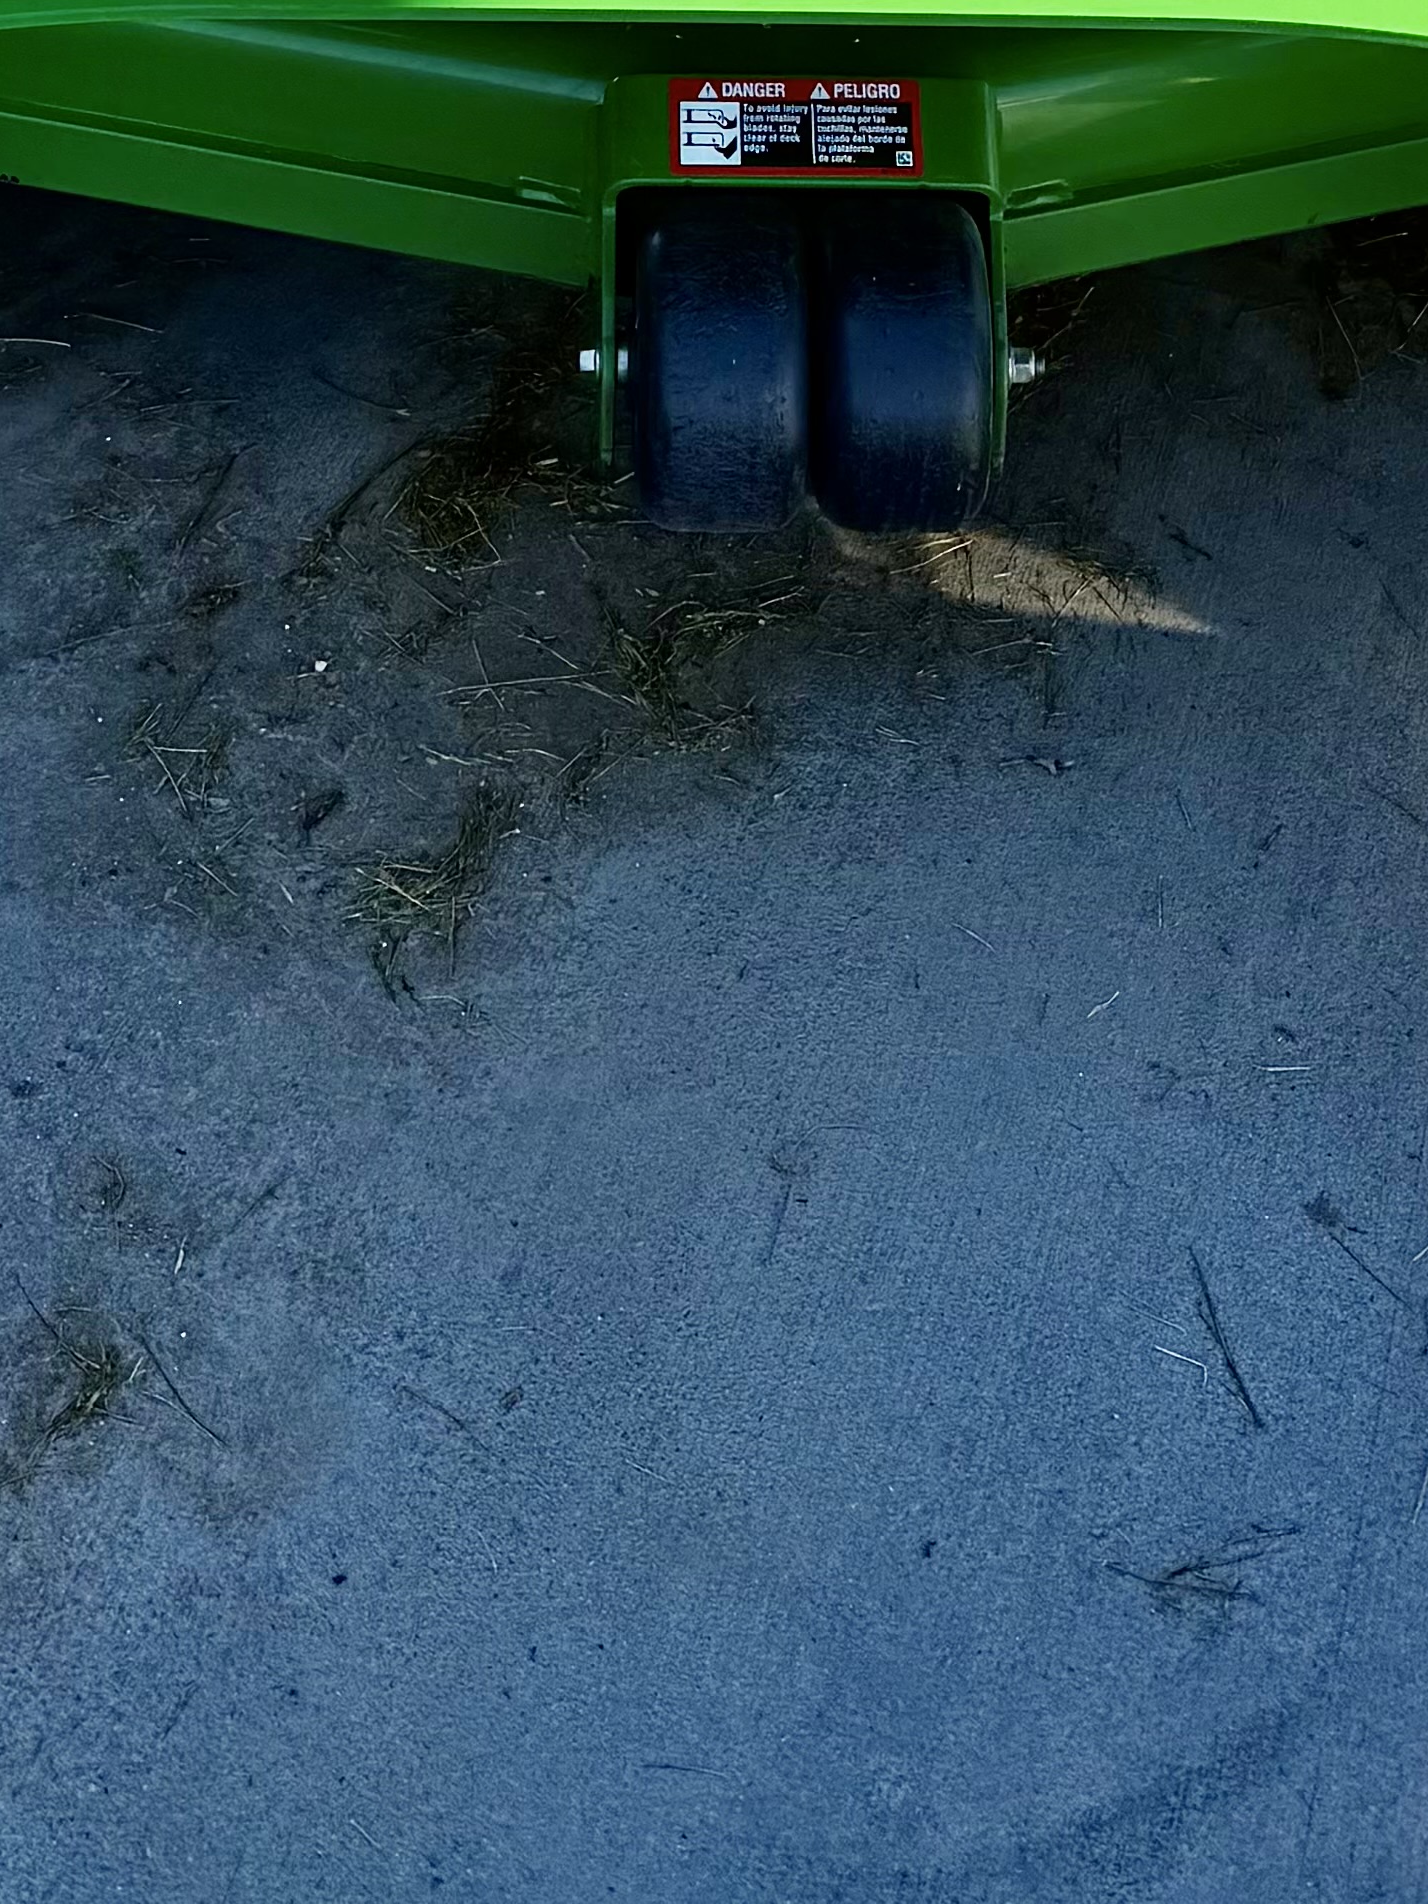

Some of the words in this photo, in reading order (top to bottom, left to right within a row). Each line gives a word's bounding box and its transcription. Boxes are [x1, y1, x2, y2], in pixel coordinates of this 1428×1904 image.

[722, 82, 786, 99] DANGER
[833, 83, 901, 100] PELIGRO
[743, 103, 754, 112] To
[756, 103, 781, 113] avoid
[783, 103, 808, 115] injury
[816, 104, 836, 114] Para
[837, 104, 862, 113] evitar
[862, 104, 898, 114] lesiones
[743, 113, 764, 123] from
[766, 113, 801, 124] rotating
[816, 115, 856, 123] causadas
[857, 115, 872, 125] por
[873, 115, 886, 124] las
[779, 124, 797, 134] stay
[743, 133, 767, 143] clear
[779, 133, 801, 143] deck
[817, 134, 850, 144] alejado
[852, 134, 866, 143] del
[868, 134, 893, 144] borde
[817, 144, 827, 153] la
[828, 144, 875, 154] plataforma
[818, 154, 829, 163] de
